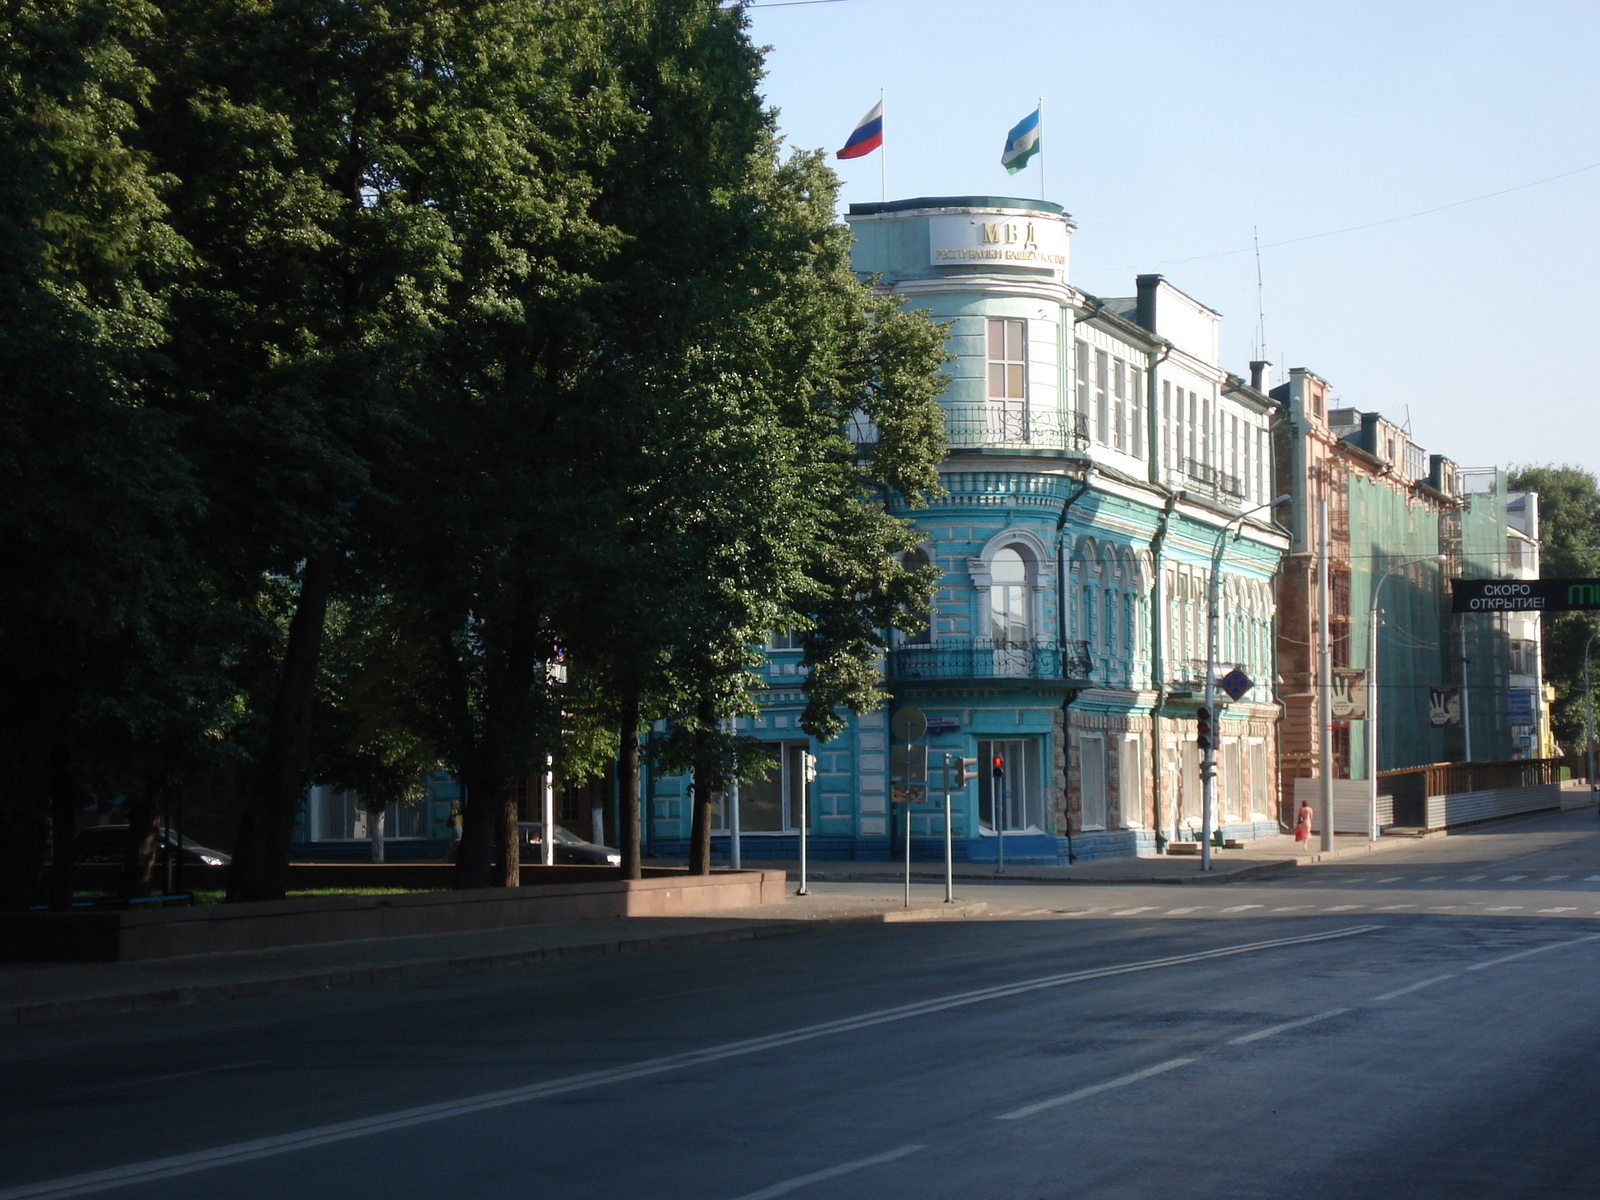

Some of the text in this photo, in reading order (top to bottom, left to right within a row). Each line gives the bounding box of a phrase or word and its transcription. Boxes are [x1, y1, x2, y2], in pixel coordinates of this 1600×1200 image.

[983, 222, 1038, 251] МВД
[936, 249, 1002, 262] РЕСПУБЛИКИ
[1484, 584, 1531, 596] СКОРО
[1470, 597, 1545, 610] ОТКРЫТИЕ!
